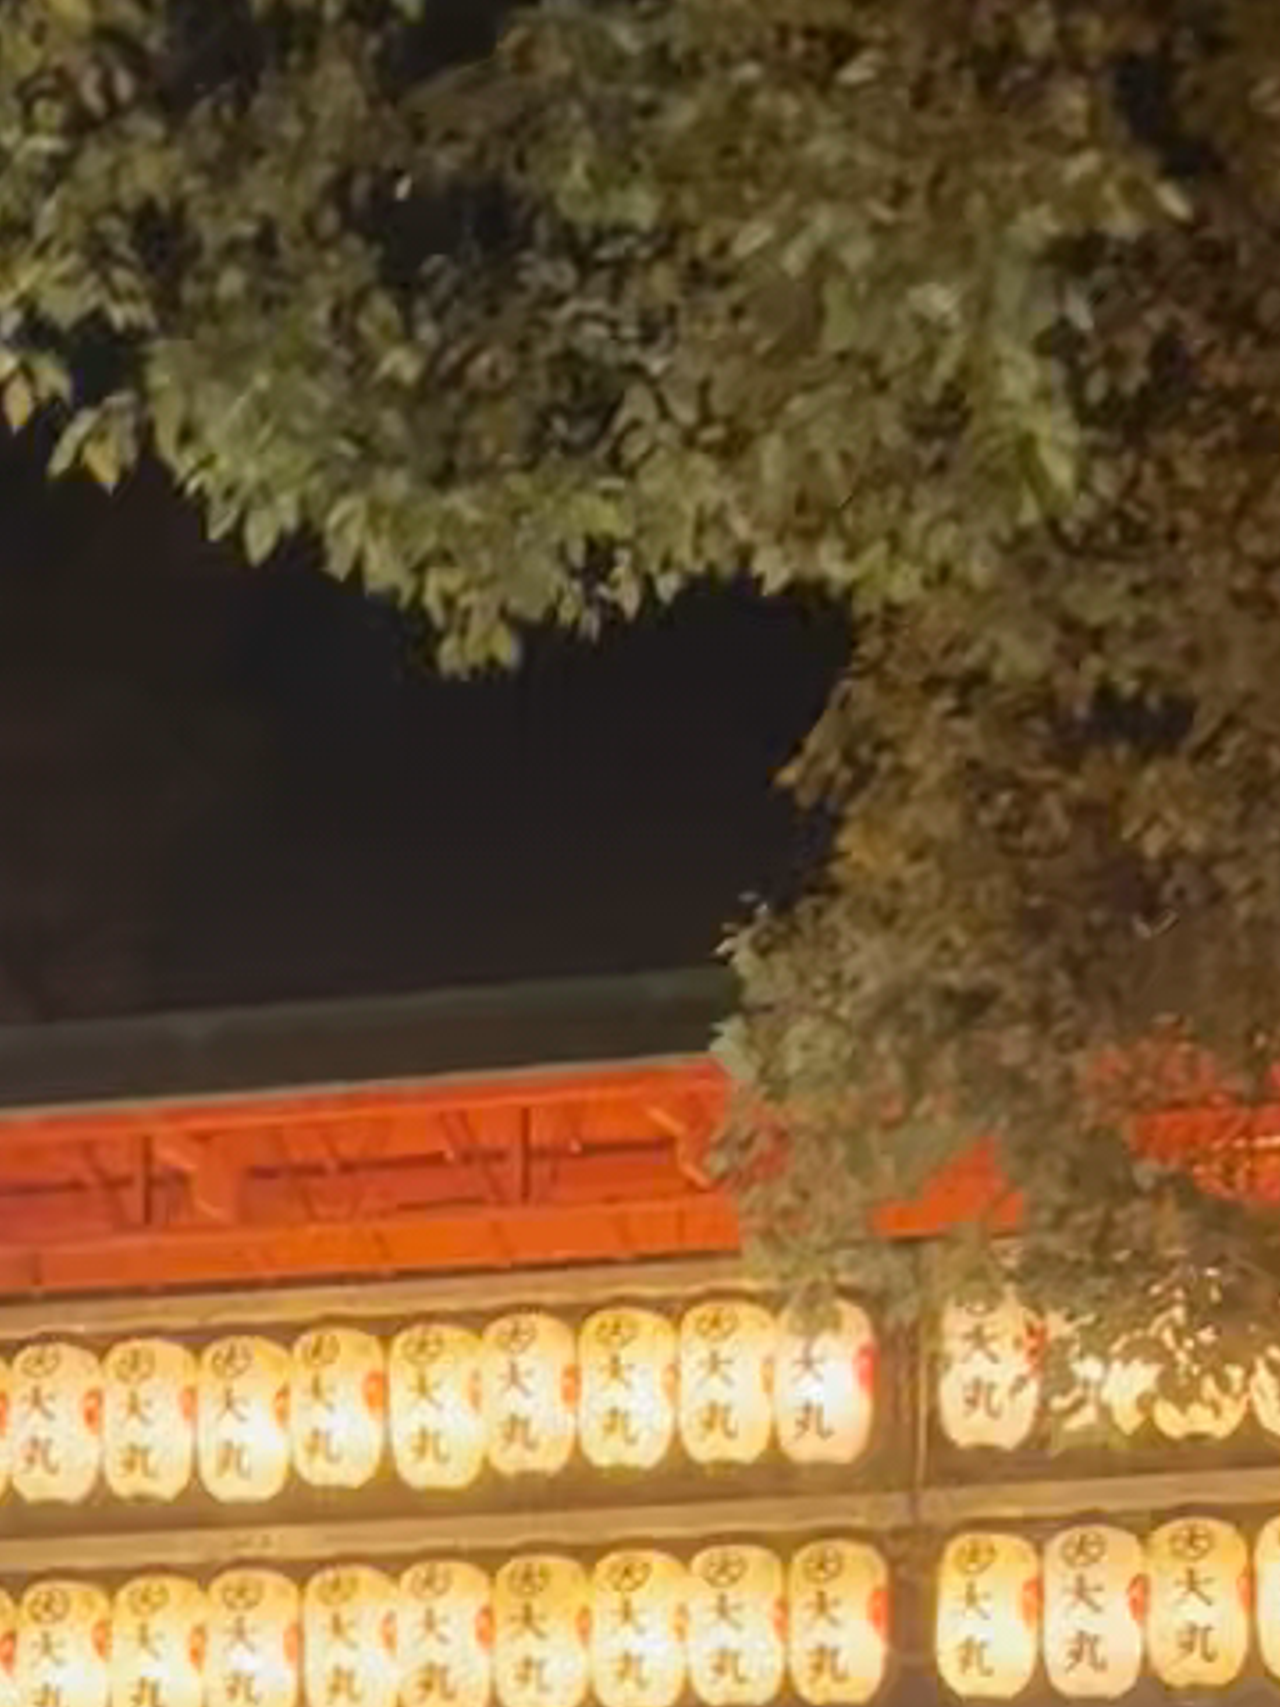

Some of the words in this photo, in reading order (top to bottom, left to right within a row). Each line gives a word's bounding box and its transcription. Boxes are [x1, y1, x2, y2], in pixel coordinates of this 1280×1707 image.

[19, 1384, 61, 1477] 大丸
[119, 1387, 158, 1480] 大丸
[215, 1385, 255, 1480] 大丸
[303, 1373, 343, 1465] 大丸
[408, 1370, 452, 1466] 大丸
[495, 1358, 540, 1452] 大丸
[600, 1353, 640, 1448] 大丸
[695, 1348, 741, 1442] 大丸
[790, 1335, 836, 1443] 大丸
[224, 1614, 261, 1707] 大丸
[321, 1612, 364, 1706] 大丸
[413, 1605, 458, 1703] 大丸
[508, 1601, 551, 1694] 大丸
[607, 1597, 651, 1693] 大丸
[706, 1592, 749, 1685] 大丸
[802, 1589, 851, 1683] 大丸
[955, 1582, 996, 1679] 大丸
[1060, 1573, 1109, 1673] 大丸
[1172, 1567, 1220, 1665] 大丸
